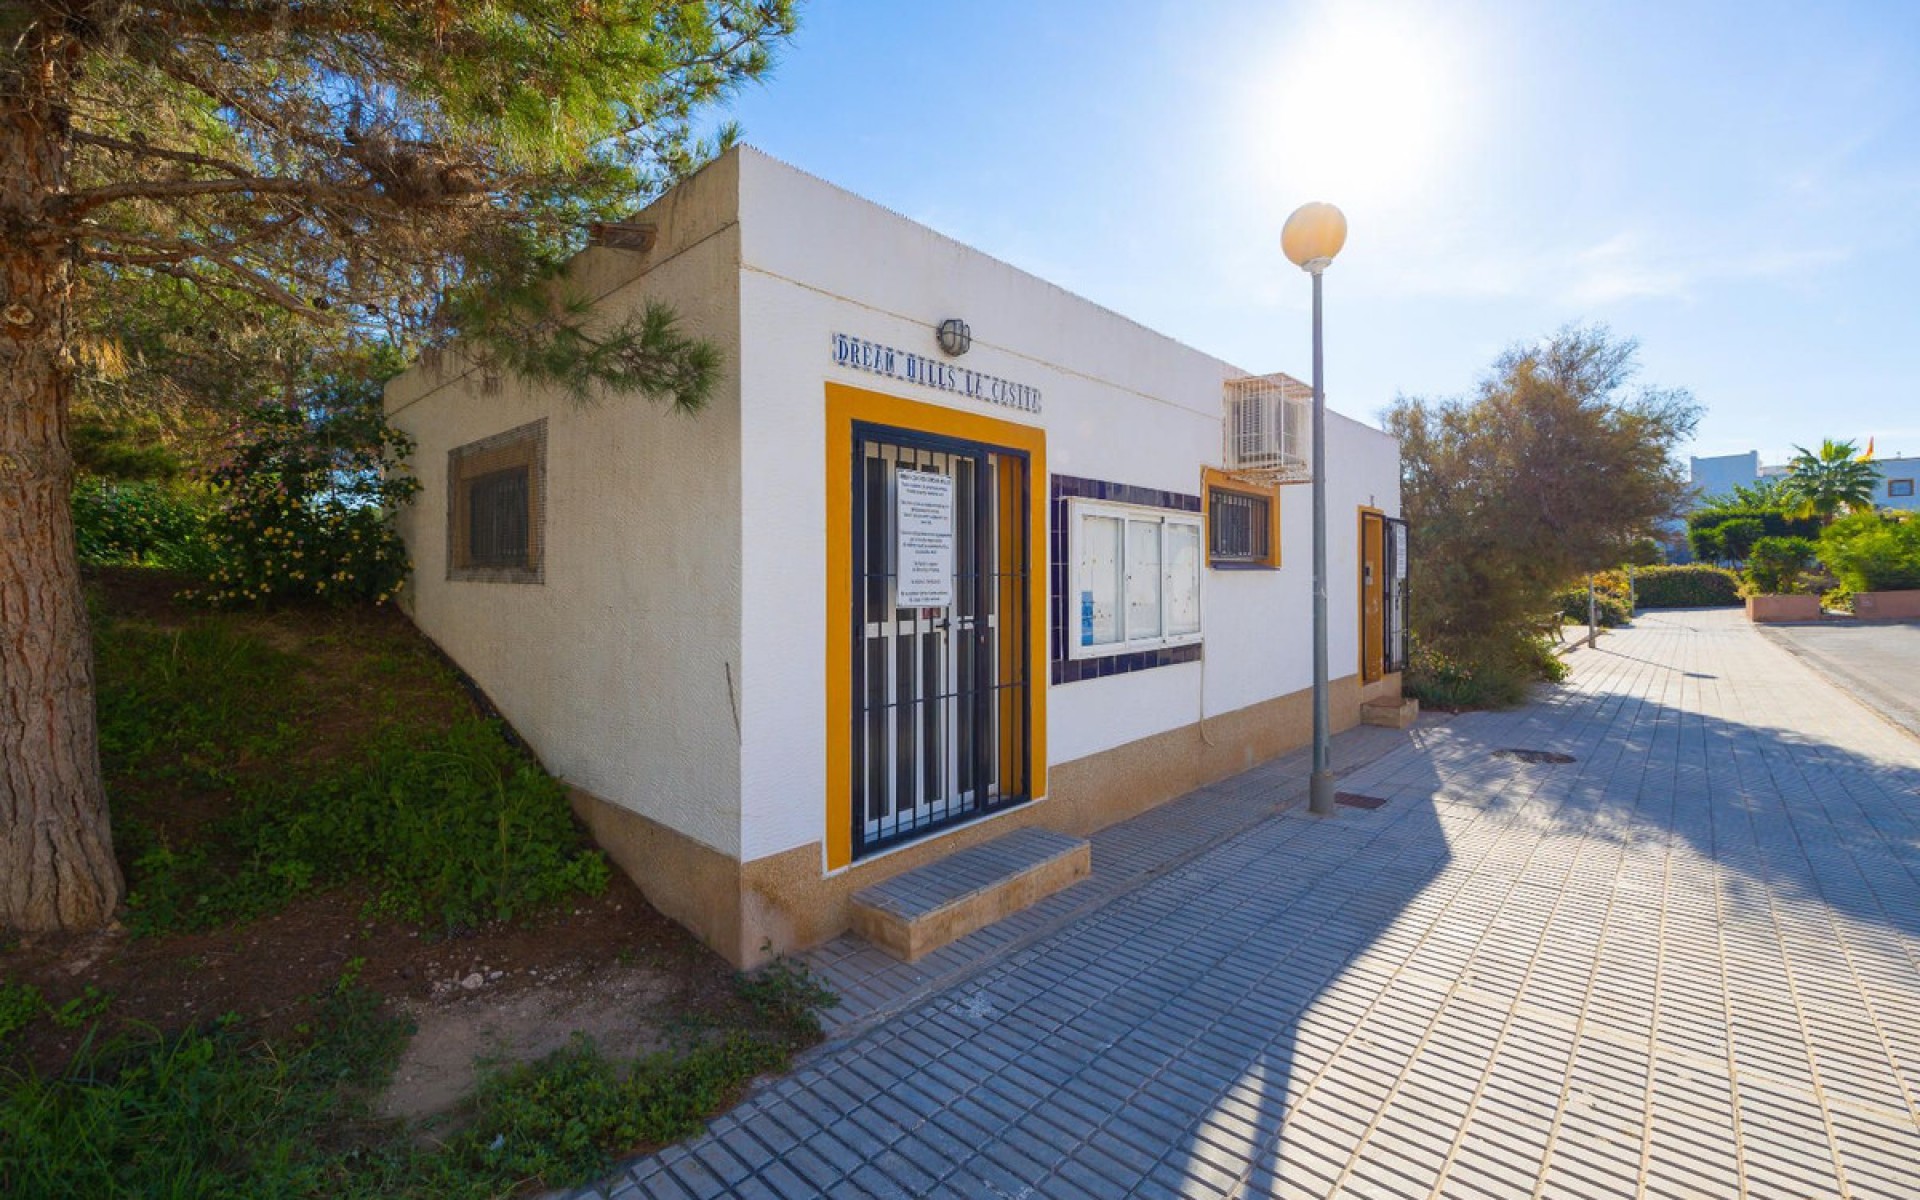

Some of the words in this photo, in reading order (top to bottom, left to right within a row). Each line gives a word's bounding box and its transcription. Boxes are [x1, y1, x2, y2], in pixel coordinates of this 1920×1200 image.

[838, 339, 895, 373] DREAM
[906, 356, 956, 388] HILLS
[966, 374, 983, 396] LA
